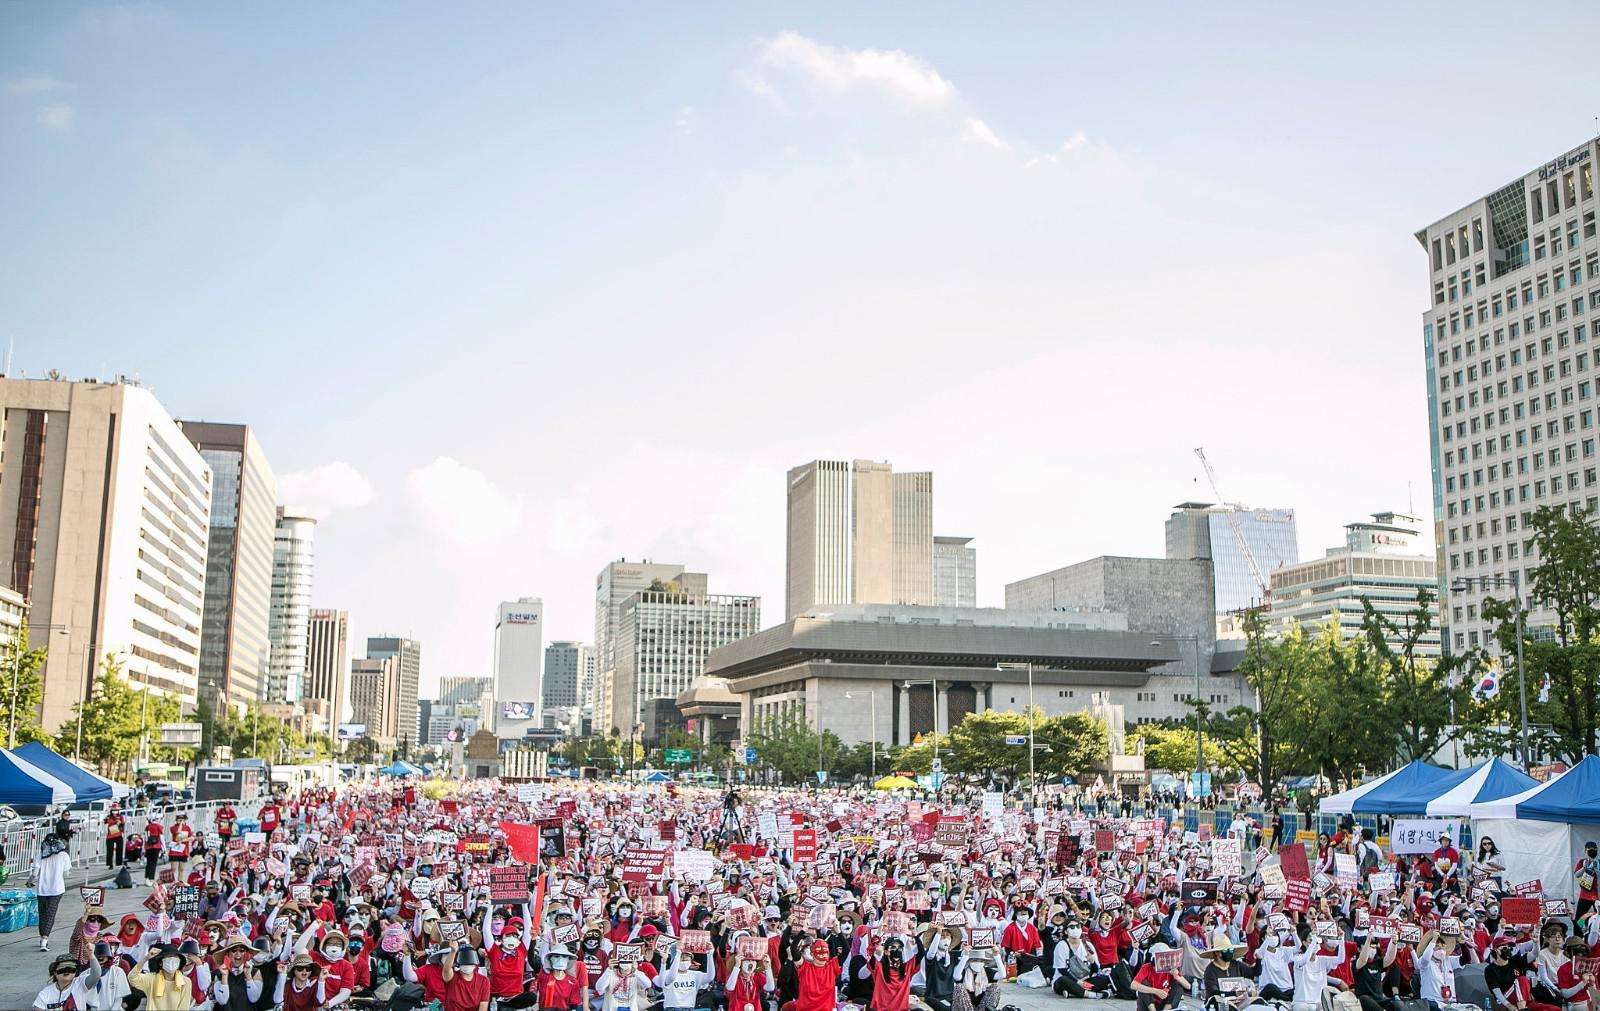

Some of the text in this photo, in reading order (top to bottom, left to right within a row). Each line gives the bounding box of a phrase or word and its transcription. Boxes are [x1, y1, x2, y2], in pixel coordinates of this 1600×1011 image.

[1538, 150, 1590, 181] 외교부 MOFA
[505, 867, 517, 875] GIRL
[519, 867, 527, 875] GO
[1440, 926, 1459, 934] PORN
[557, 933, 578, 943] PORN
